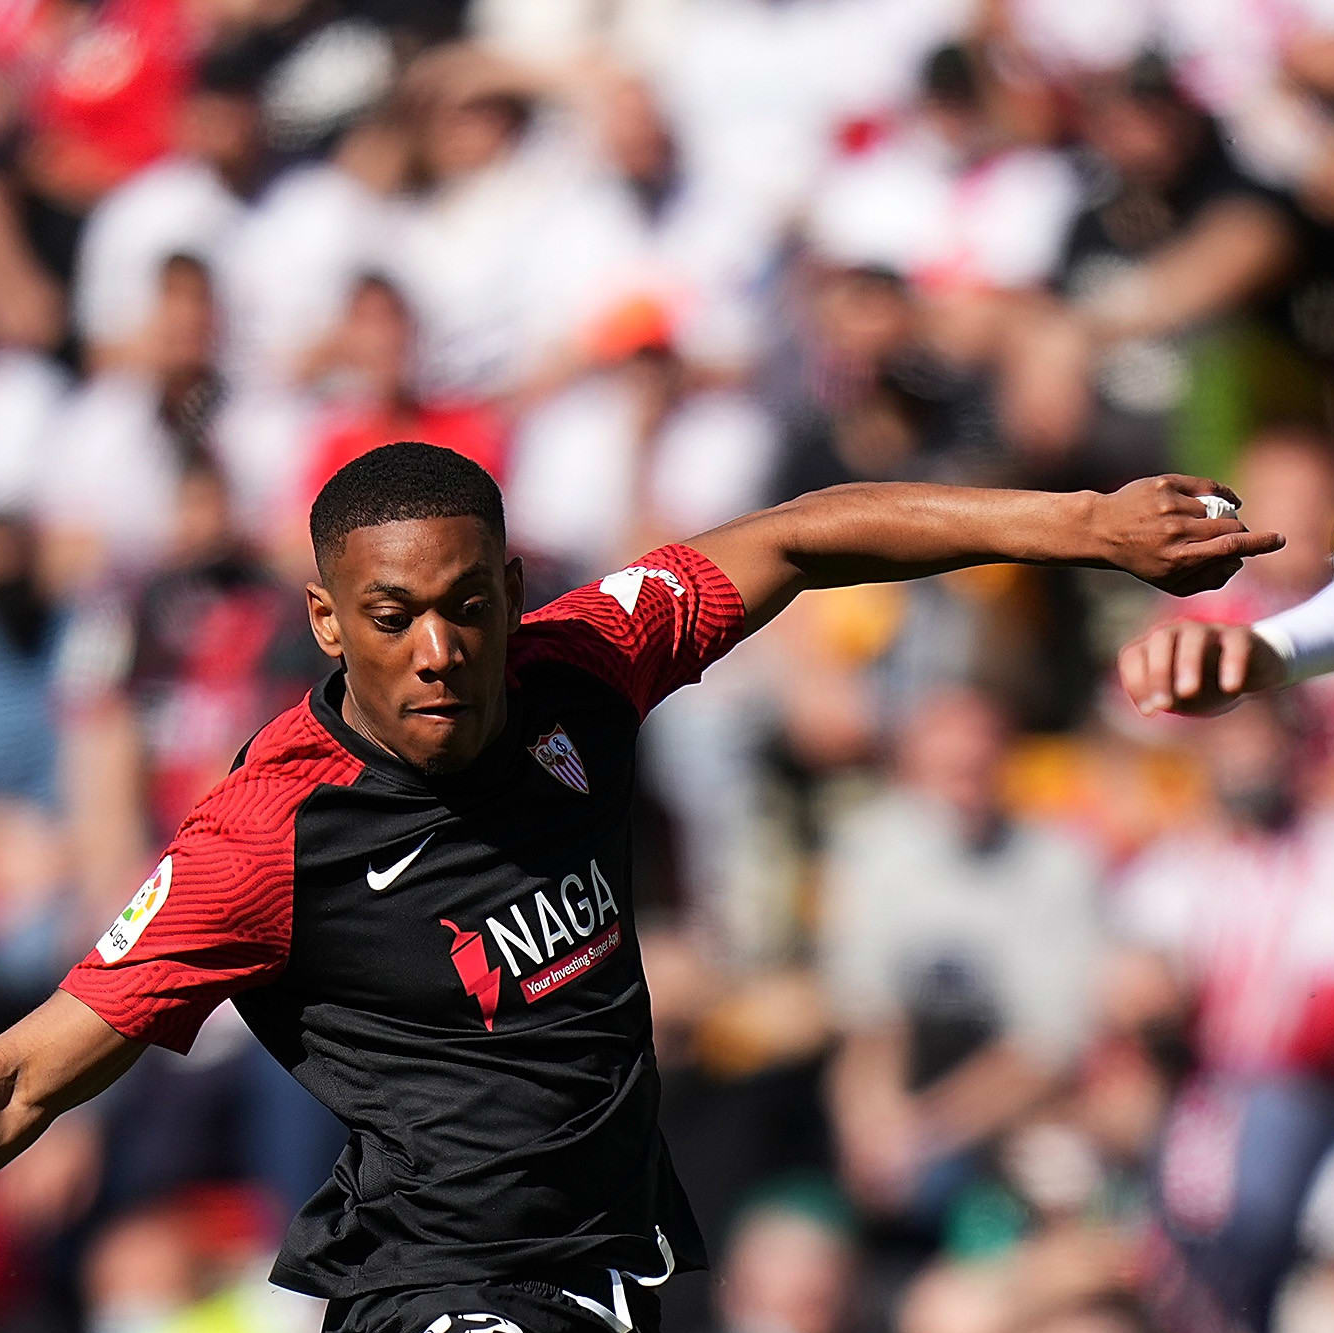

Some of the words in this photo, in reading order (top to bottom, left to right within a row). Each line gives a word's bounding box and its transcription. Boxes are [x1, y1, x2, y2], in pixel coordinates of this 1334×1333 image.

[485, 858, 619, 978] NAGA
[527, 976, 551, 995] Your
[550, 954, 591, 984] Investing
[588, 940, 609, 960] Super
[608, 931, 619, 947] App
